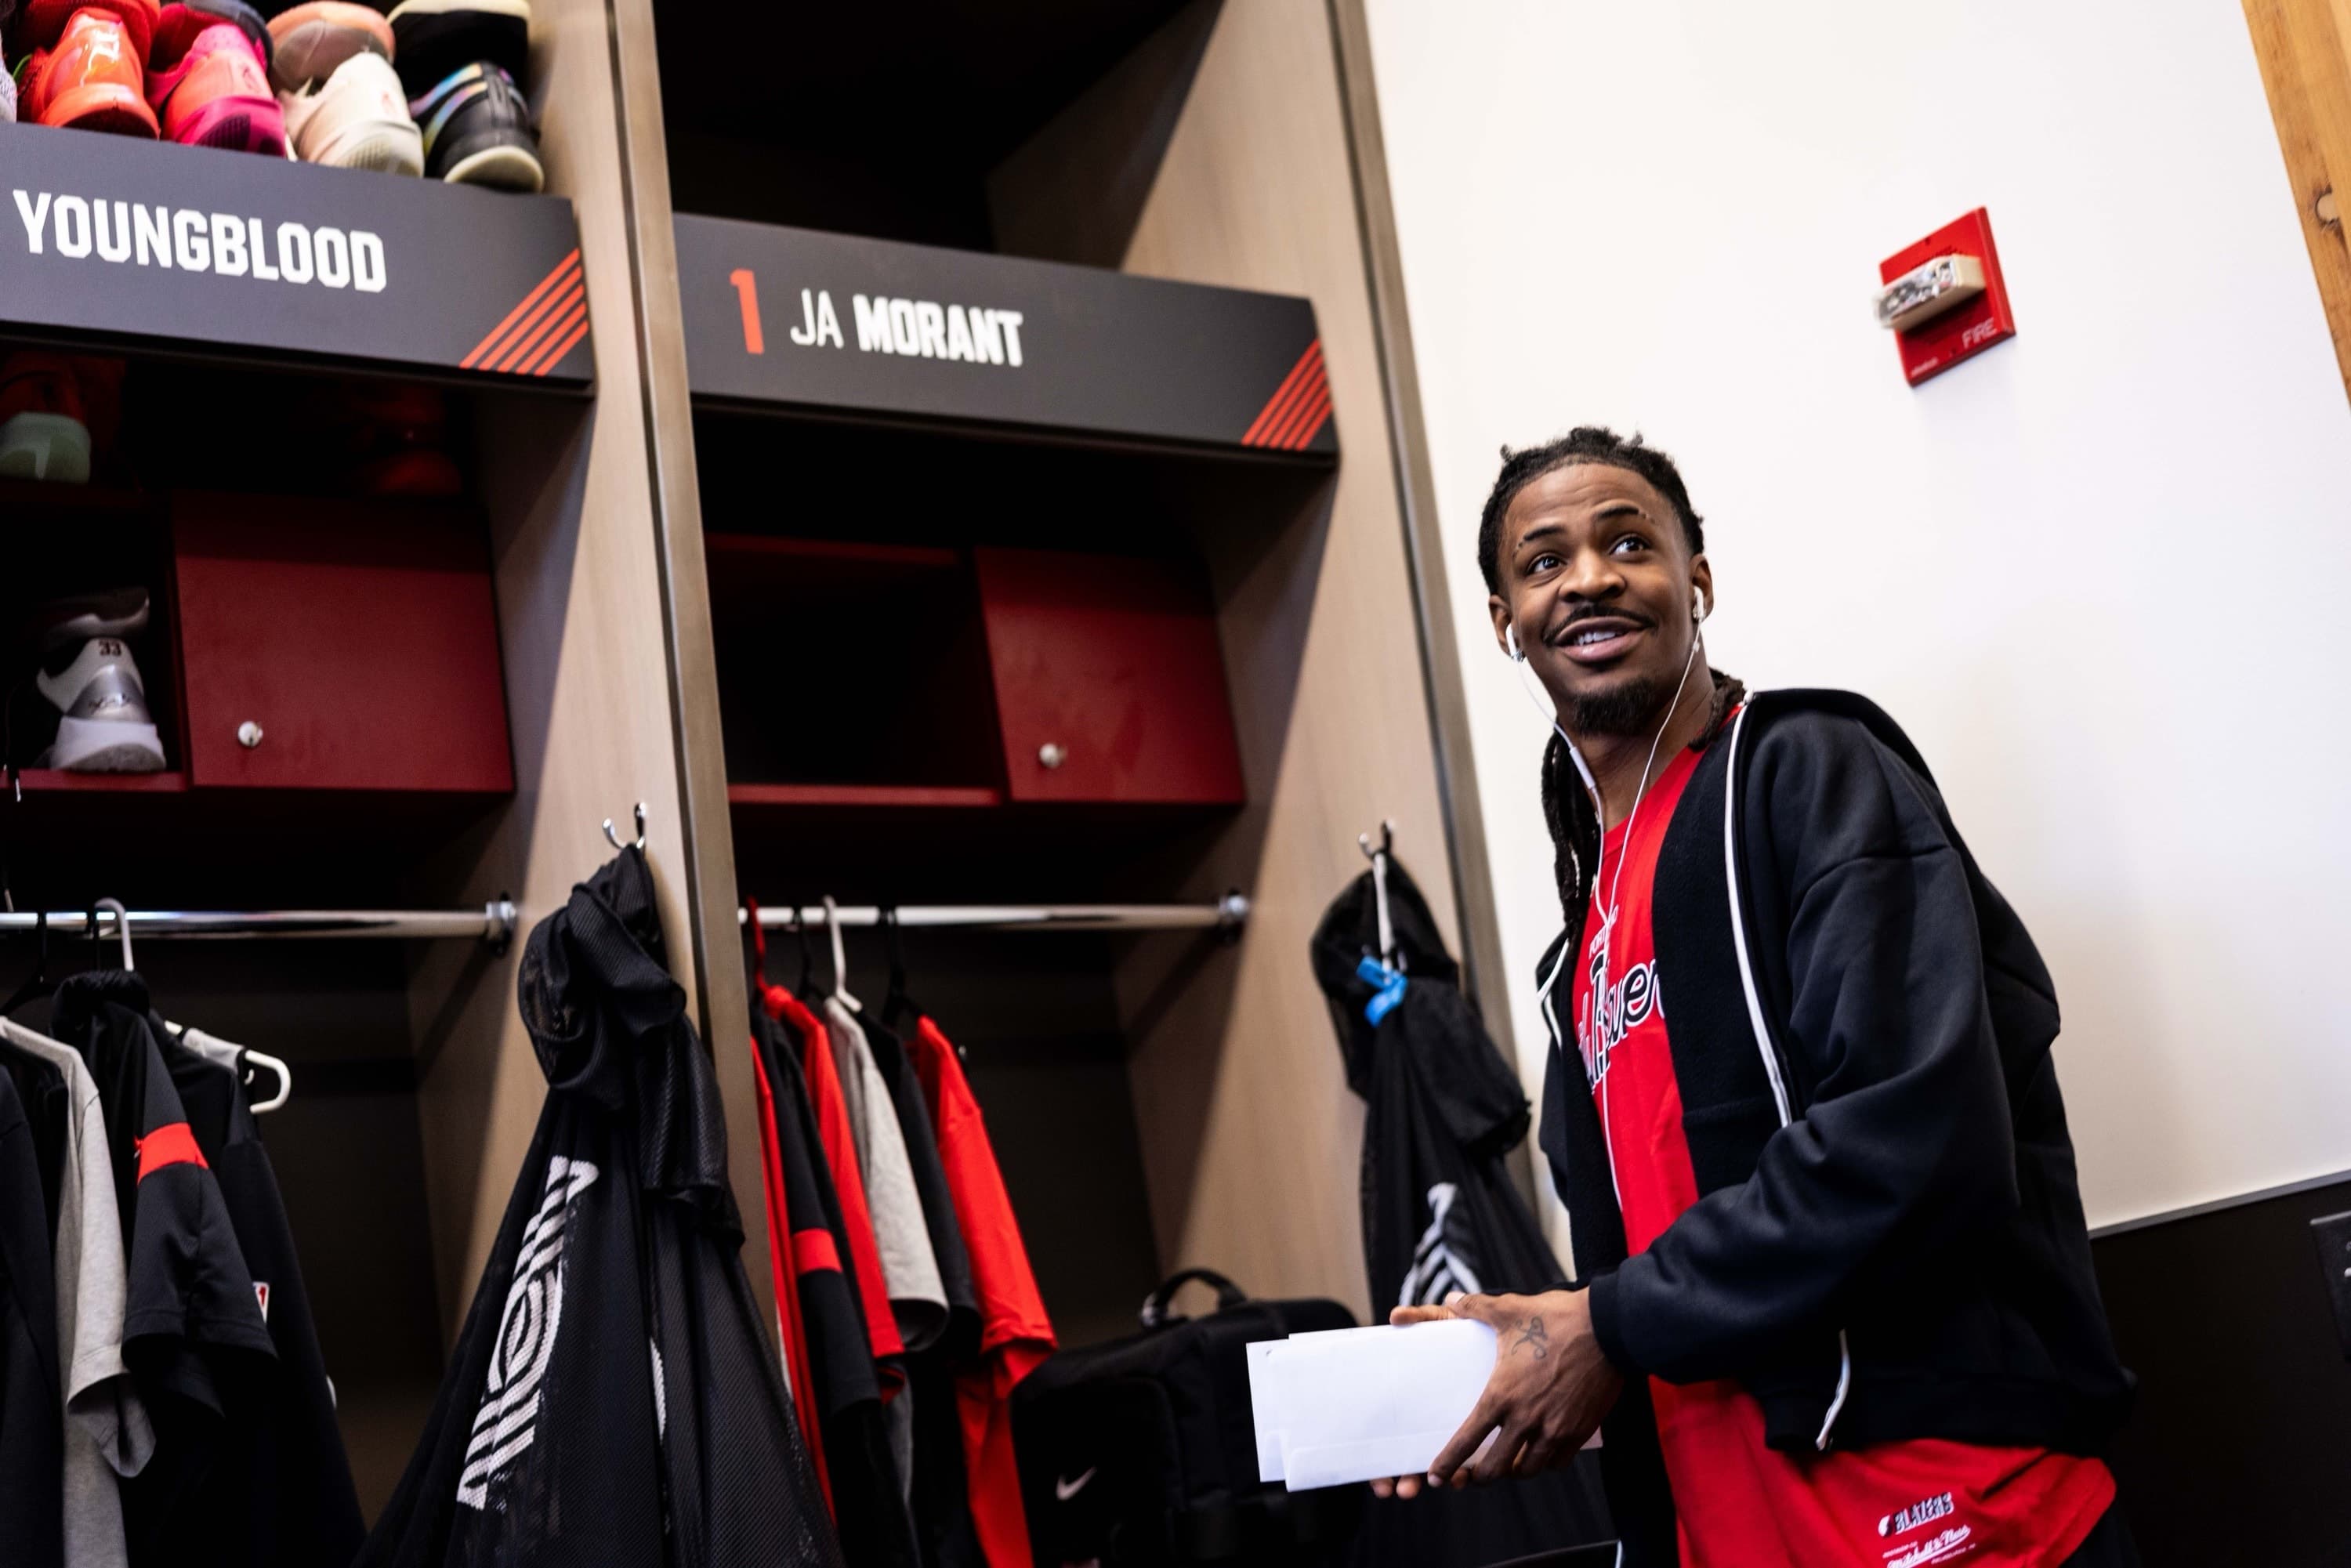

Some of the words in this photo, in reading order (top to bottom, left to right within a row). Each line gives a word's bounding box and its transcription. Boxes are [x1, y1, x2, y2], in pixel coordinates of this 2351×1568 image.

[12, 189, 388, 293] YOUNGBLOOD
[730, 268, 765, 355] 1
[790, 288, 845, 349] JA
[852, 293, 1023, 368] MORANT
[1962, 317, 1998, 349] FIRE
